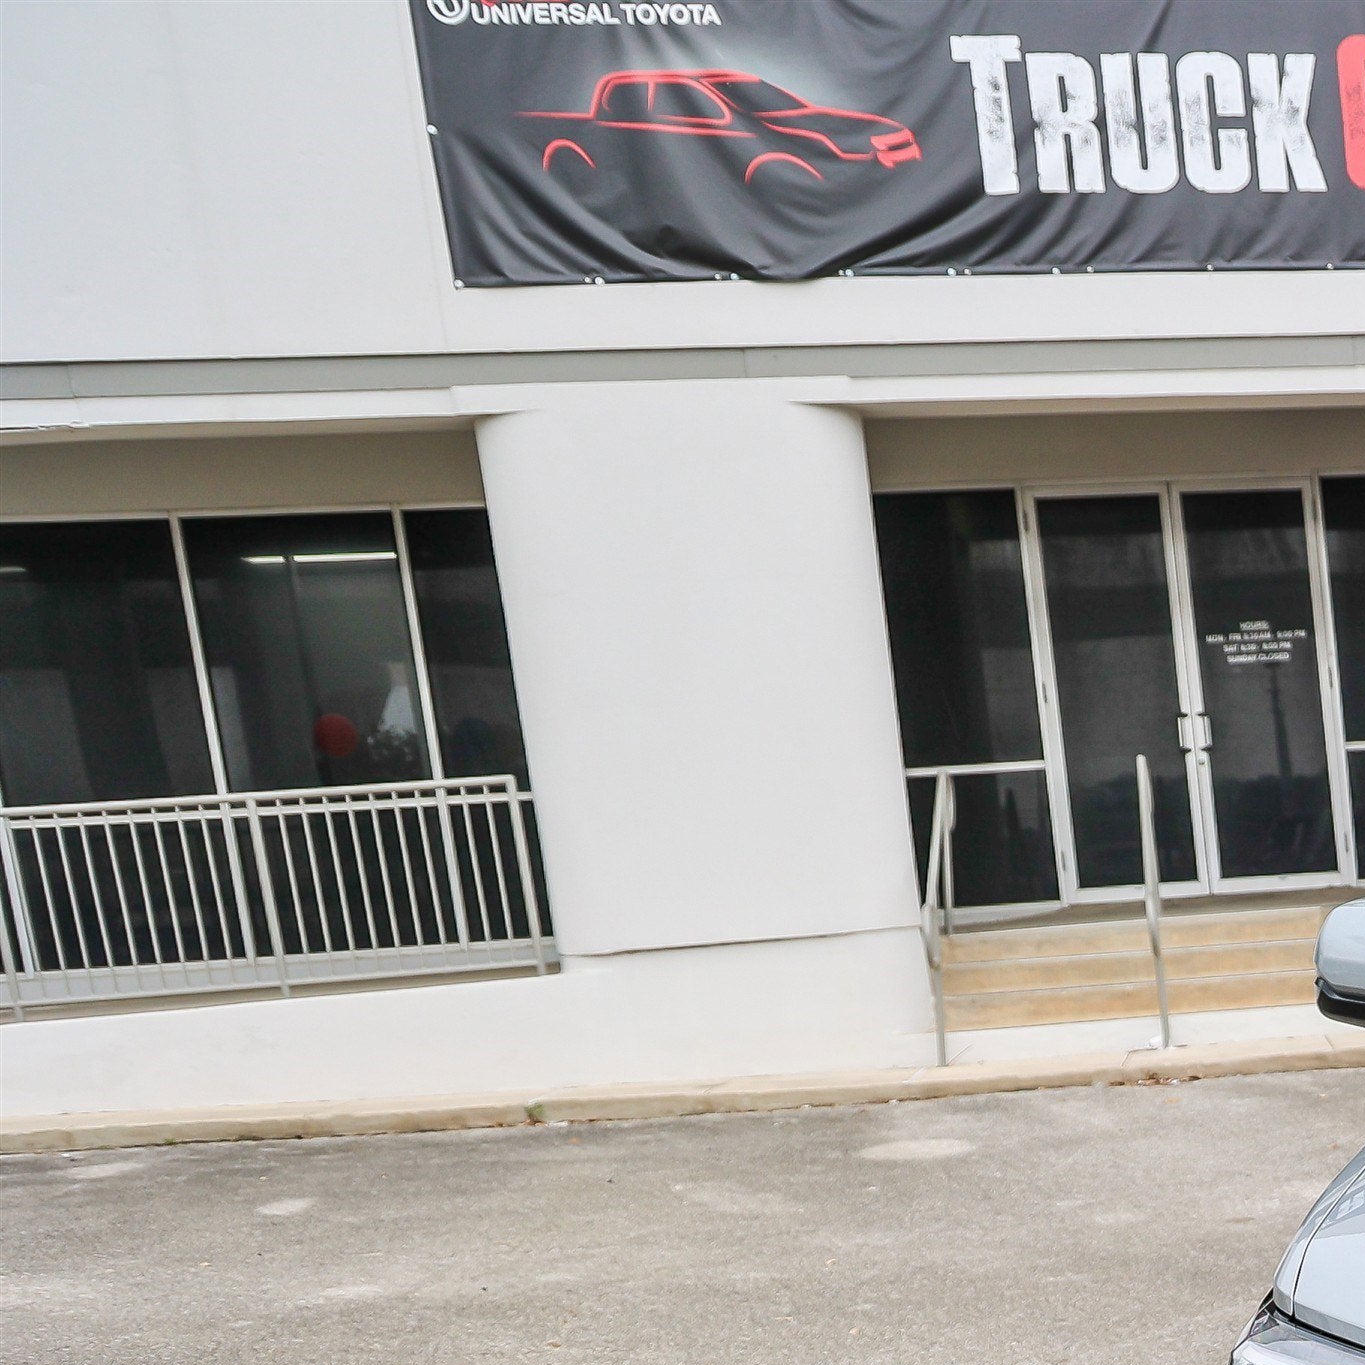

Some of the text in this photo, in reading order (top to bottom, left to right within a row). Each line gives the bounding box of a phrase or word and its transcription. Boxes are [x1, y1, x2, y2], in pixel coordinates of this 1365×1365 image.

[471, 3, 723, 26] UNIVERSAL TOYOTA
[950, 34, 1328, 196] TRUCK
